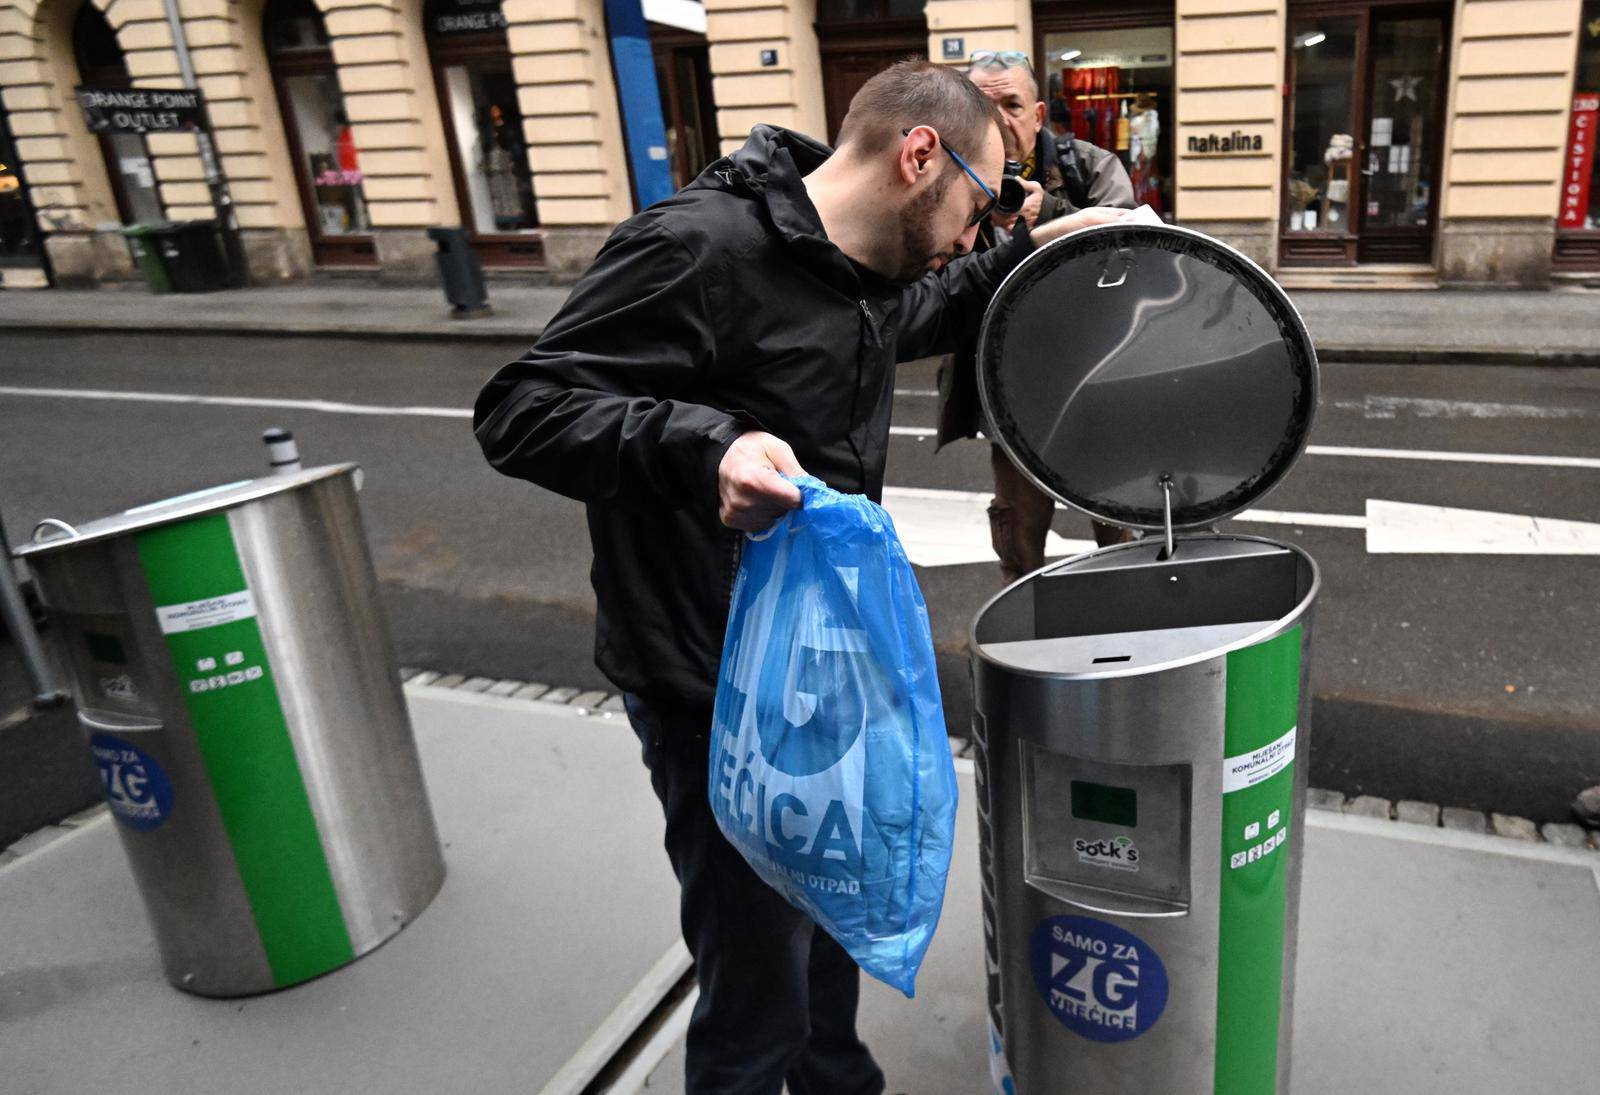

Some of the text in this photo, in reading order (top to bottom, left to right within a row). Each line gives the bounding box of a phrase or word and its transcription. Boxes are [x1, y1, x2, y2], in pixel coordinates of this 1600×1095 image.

[81, 91, 198, 109] ORANGE POINT
[113, 112, 180, 129] OUTLET
[1187, 129, 1263, 153] naftalina
[1231, 752, 1276, 774] KOMUNALNI
[808, 874, 861, 896] OTPAD
[1052, 925, 1140, 961] SAMO ZA
[1051, 955, 1139, 1012] ZG
